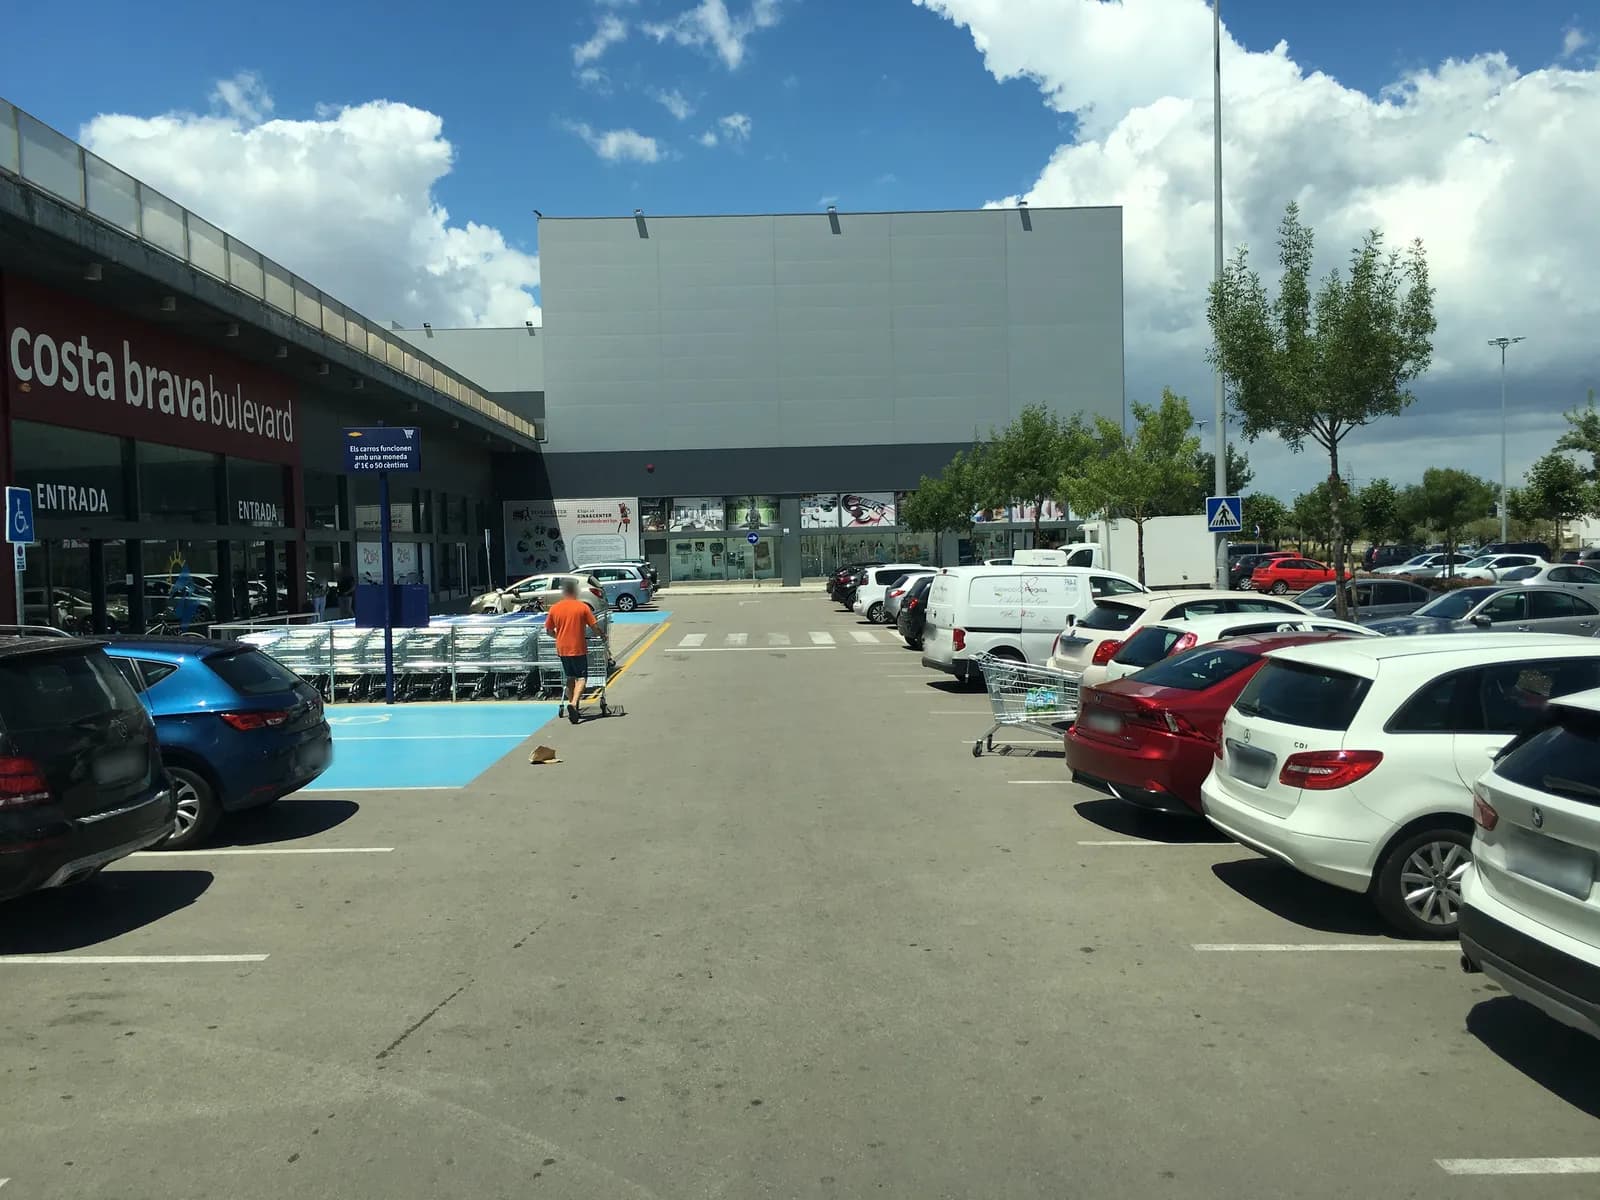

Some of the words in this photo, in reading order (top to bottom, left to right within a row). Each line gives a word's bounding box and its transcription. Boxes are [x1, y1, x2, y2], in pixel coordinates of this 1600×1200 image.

[10, 327, 115, 400] costa
[123, 340, 206, 422] brava
[209, 374, 293, 442] bulevard
[36, 483, 109, 512] ENTRADA
[238, 500, 277, 521] ENTRADA
